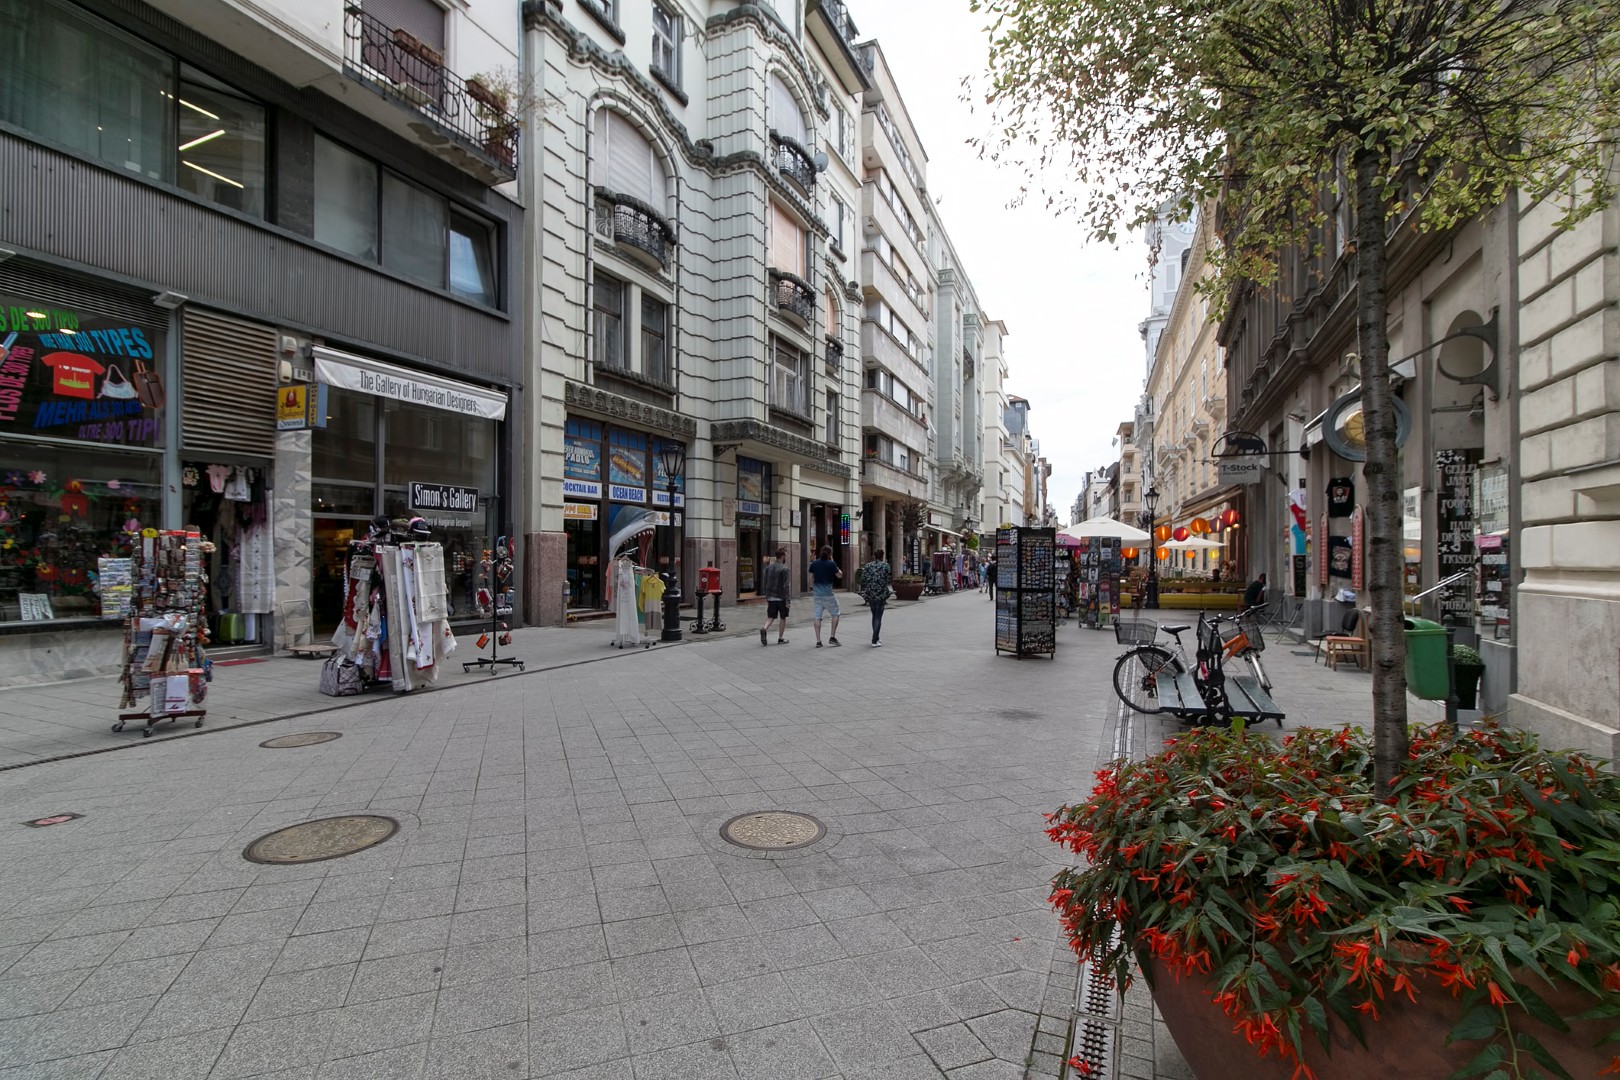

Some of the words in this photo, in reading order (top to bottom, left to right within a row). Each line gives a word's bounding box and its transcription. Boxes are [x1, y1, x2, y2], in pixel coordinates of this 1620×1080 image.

[10, 306, 30, 331] DE
[53, 310, 79, 331] TIPOS
[73, 331, 95, 353] 300
[90, 328, 153, 360] TYPES
[360, 370, 373, 391] The
[375, 374, 401, 399] Gallery
[402, 382, 411, 398] of
[412, 383, 446, 406] Hungarian
[446, 390, 478, 412] Designers
[33, 400, 88, 430] MEHR
[103, 421, 124, 440] 300
[126, 418, 160, 442] TIPI
[1221, 463, 1258, 472] T-Stock
[415, 484, 448, 508] Simon's
[449, 487, 477, 512] Gallery
[587, 485, 598, 494] BAR
[612, 486, 629, 499] OCEAN
[629, 488, 643, 501] BEACH
[657, 494, 681, 504] RESTAANT
